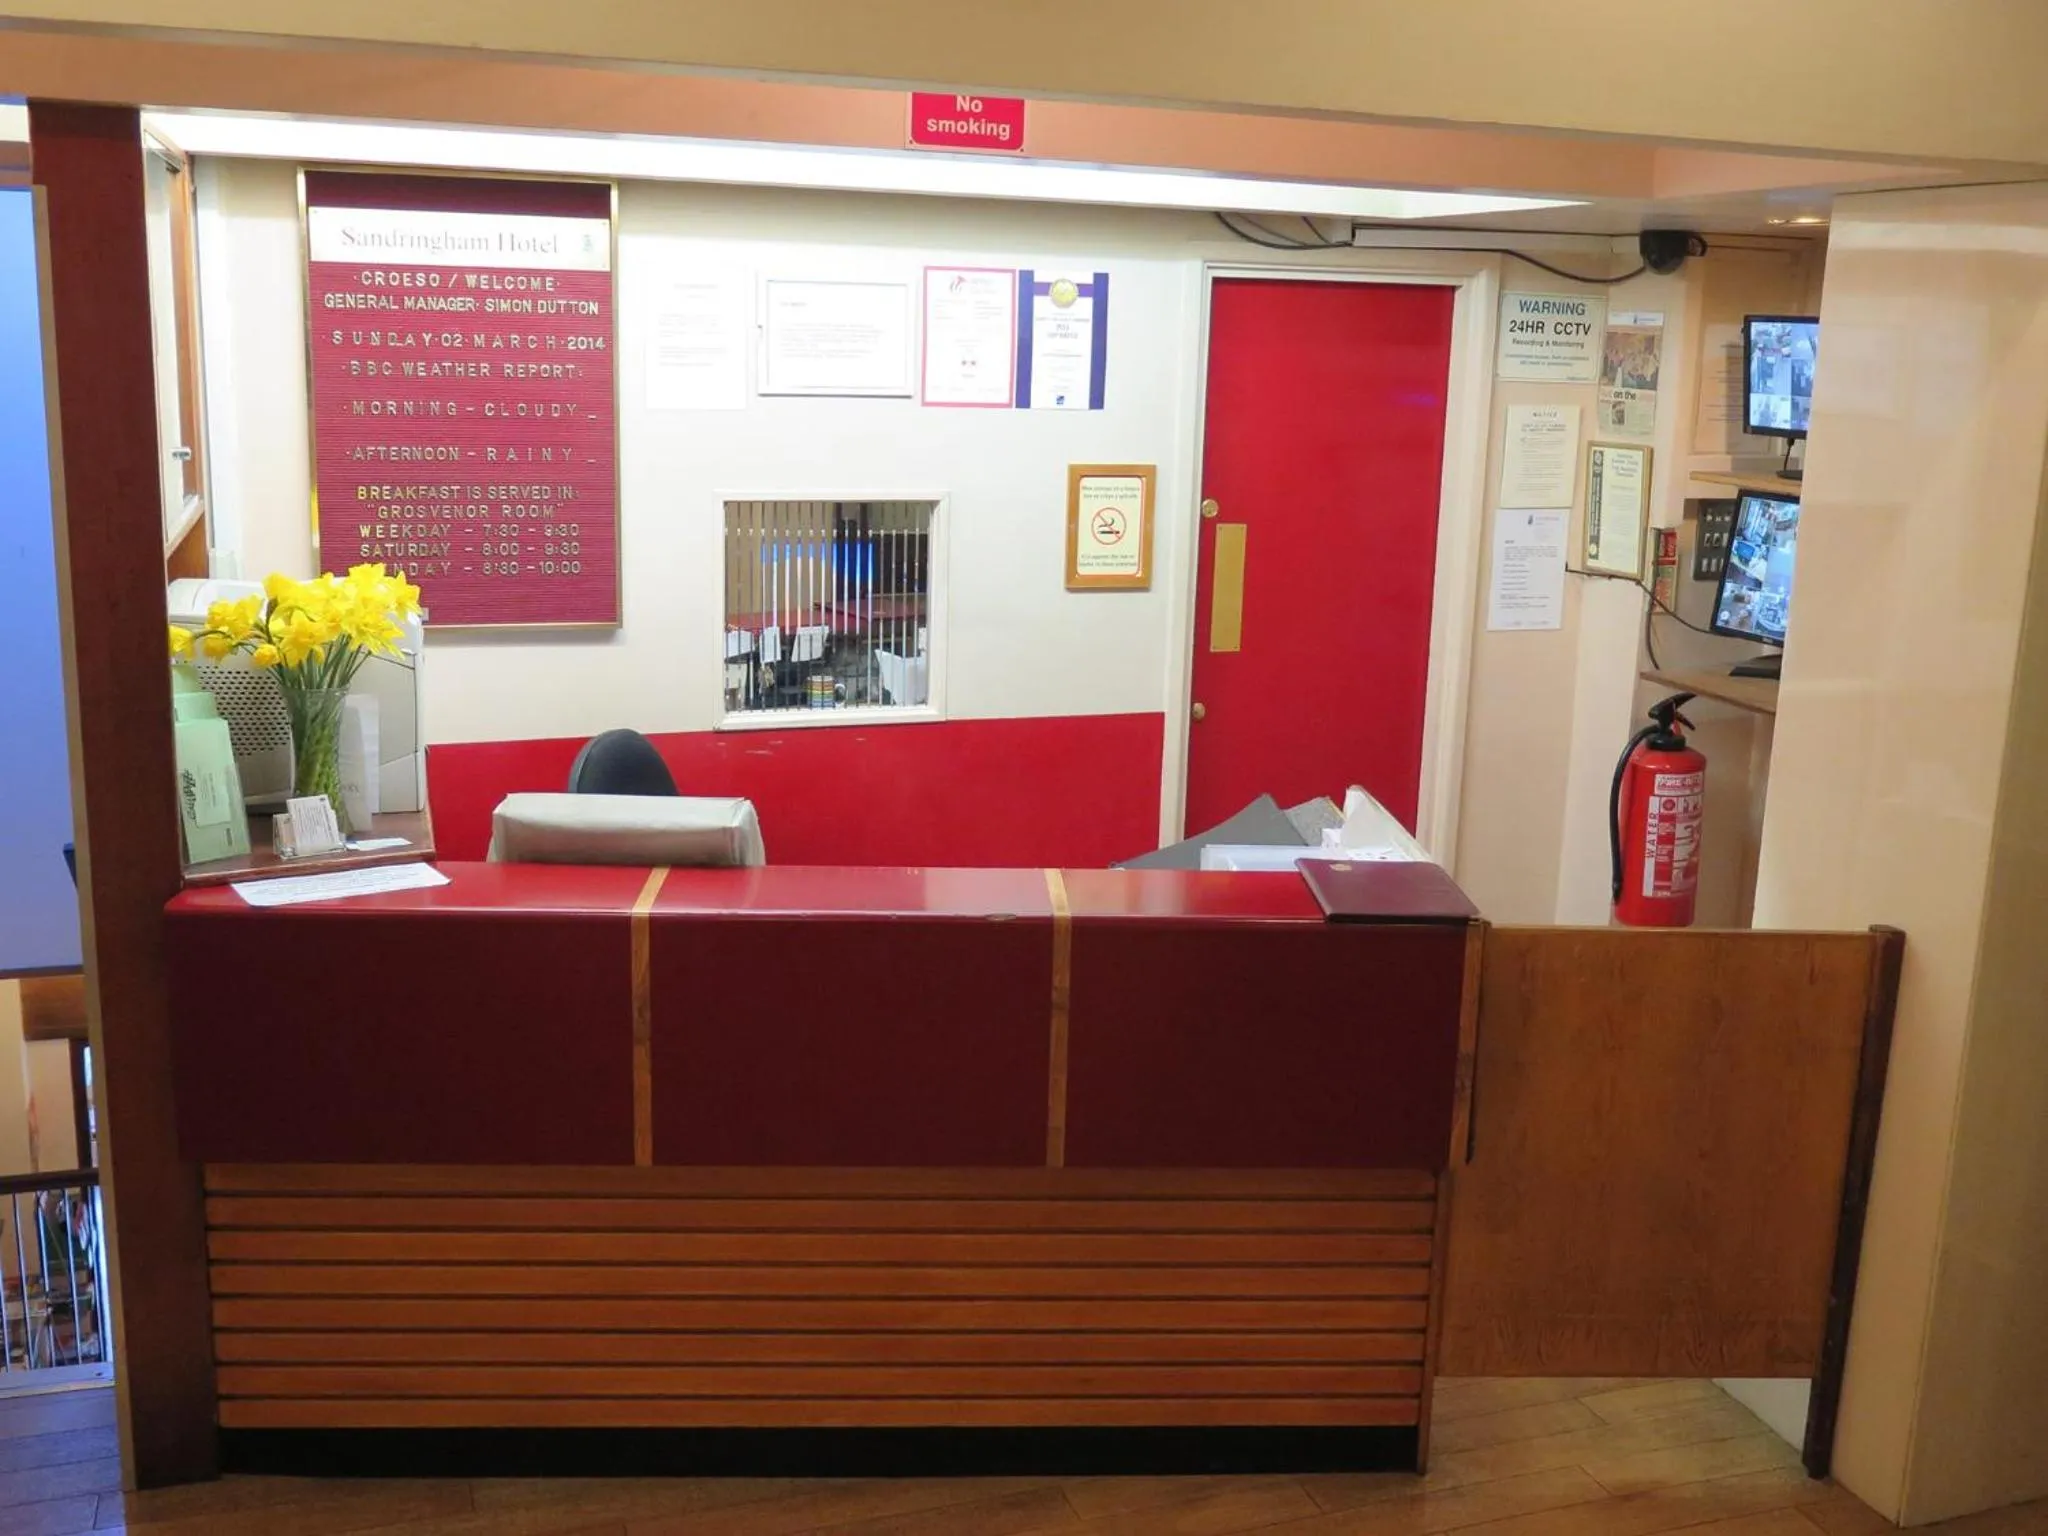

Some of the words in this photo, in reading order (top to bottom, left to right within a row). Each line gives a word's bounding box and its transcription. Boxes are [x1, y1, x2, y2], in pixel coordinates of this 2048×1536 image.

[956, 94, 984, 113] No
[926, 117, 1011, 141] smoking
[341, 227, 490, 255] Sandringham
[498, 233, 560, 255] Hotel
[360, 270, 442, 288] CROESO
[464, 273, 556, 292] WELCOME
[323, 292, 400, 310] GENERAL
[484, 297, 534, 314] SIMON
[537, 300, 600, 315] DUTTON
[1519, 299, 1586, 317] WARNING
[1509, 319, 1546, 335] 24HR
[1553, 321, 1592, 337] CCTV
[566, 335, 606, 350] 2014
[402, 361, 491, 378] WEATHER
[351, 400, 458, 417] MORNING
[484, 403, 578, 418] CLOUDY
[351, 446, 460, 462] AFTERNOON
[486, 448, 574, 463] RAINY
[356, 485, 462, 501] BREAKFAST
[466, 486, 482, 500] IS
[487, 486, 552, 500] SERVED
[359, 523, 452, 539] WEEKDAY
[482, 523, 520, 538] 7:30
[359, 543, 452, 558] SATURDAY
[482, 542, 520, 557] 8:00
[482, 561, 520, 577] 8:30
[538, 560, 581, 576] 10:00
